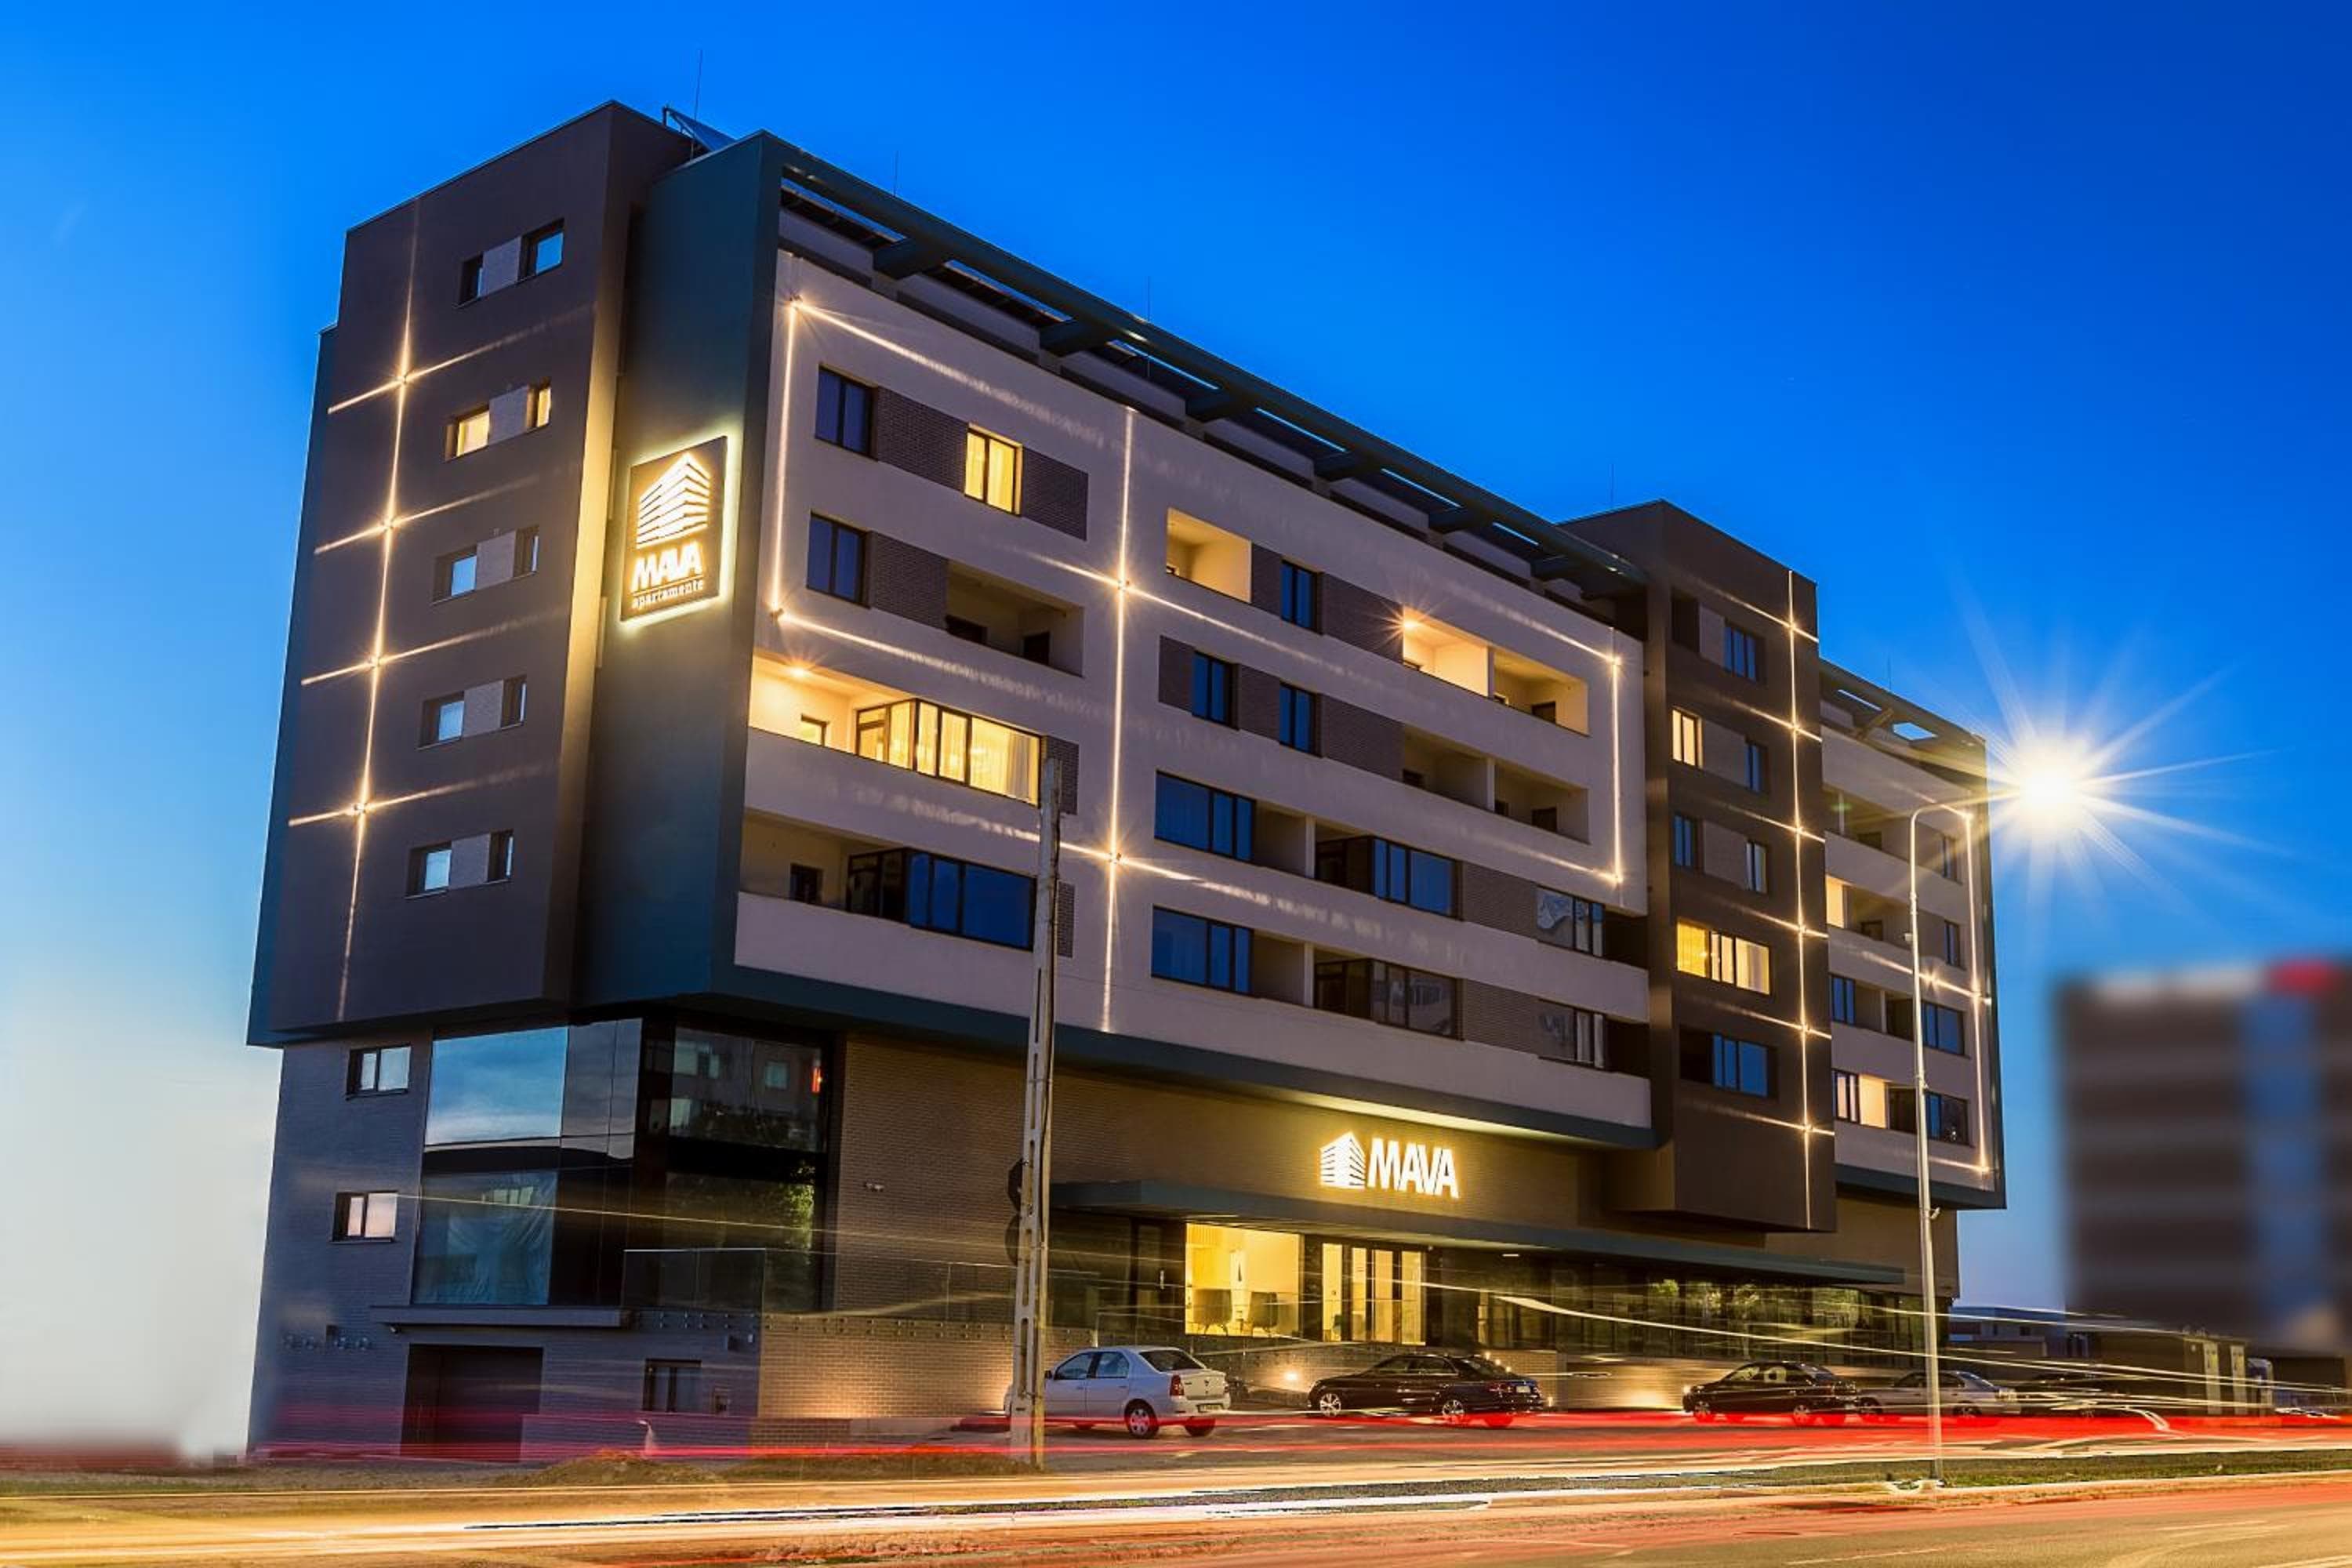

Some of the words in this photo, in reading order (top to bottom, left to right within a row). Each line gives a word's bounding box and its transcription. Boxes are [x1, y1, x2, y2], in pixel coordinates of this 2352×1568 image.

[630, 541, 703, 593] MAVA
[631, 579, 703, 608] apartamente
[1367, 1138, 1459, 1199] MAVA
